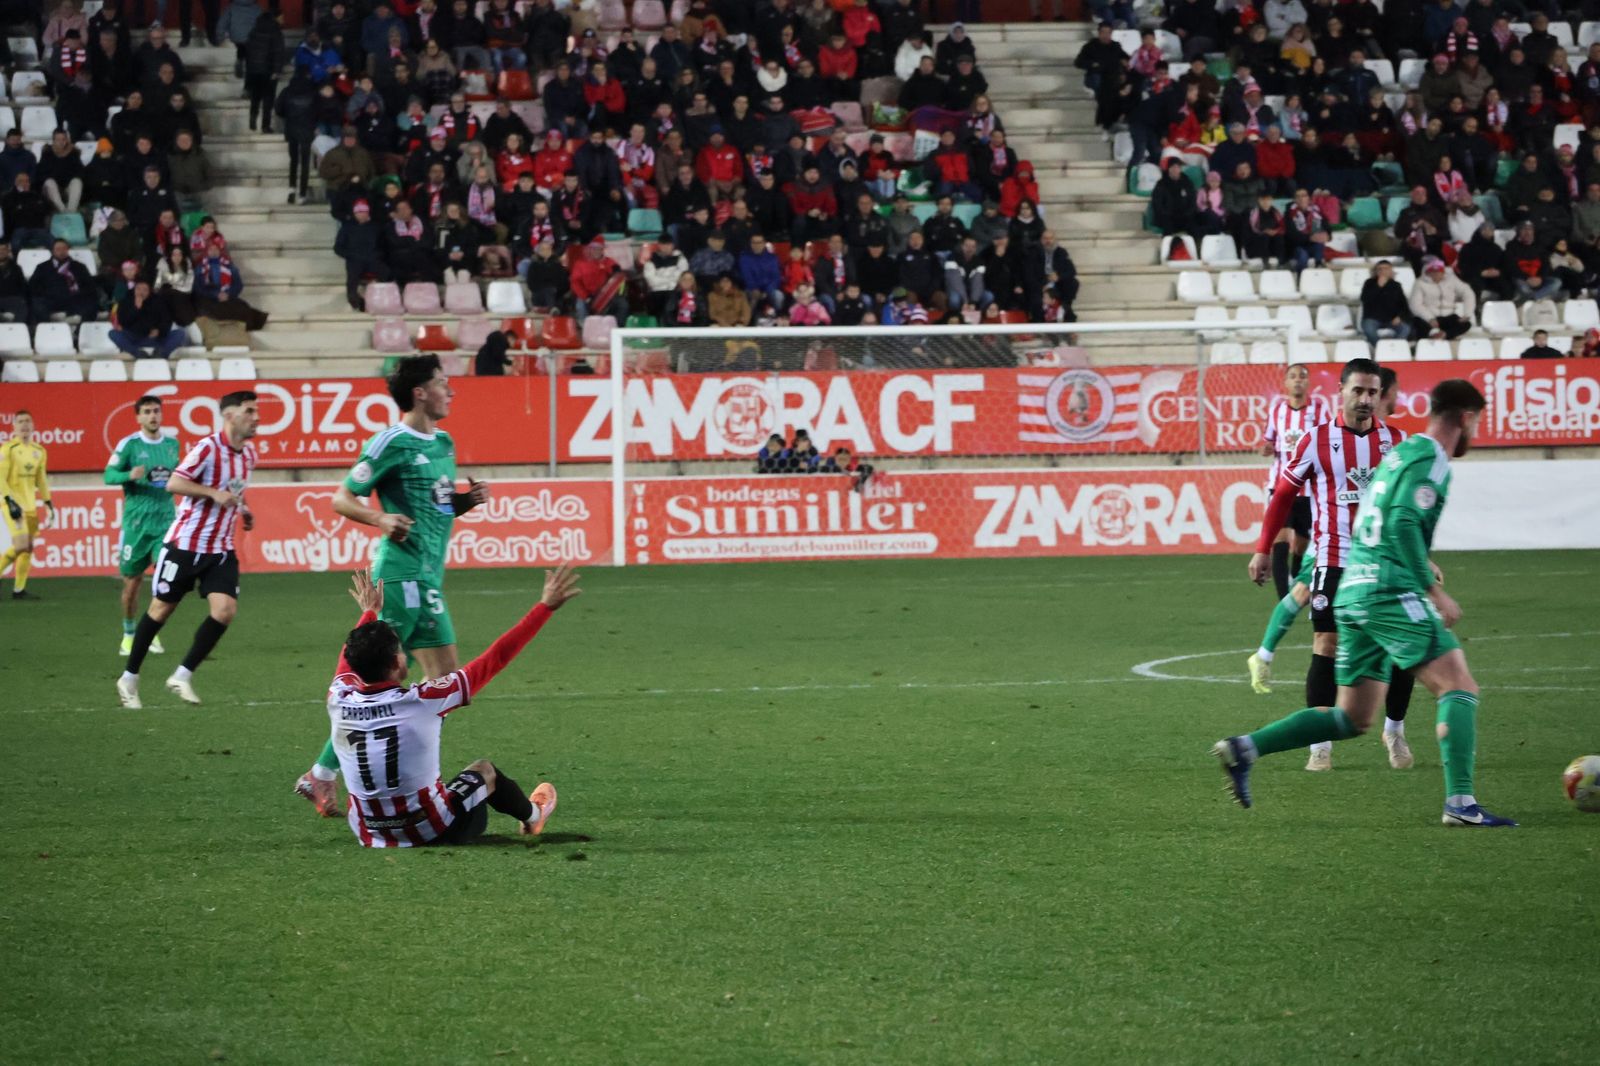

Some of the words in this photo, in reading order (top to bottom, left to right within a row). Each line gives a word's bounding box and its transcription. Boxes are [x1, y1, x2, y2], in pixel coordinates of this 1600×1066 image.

[1152, 394, 1291, 423] CENTR
[1495, 364, 1600, 414] fisio
[568, 376, 876, 457] ZAMORA
[879, 374, 985, 453] CF
[666, 490, 927, 536] Sumiller
[707, 485, 800, 504] bodegas
[973, 482, 1218, 548] ZAMORA
[32, 535, 121, 568] Castilla
